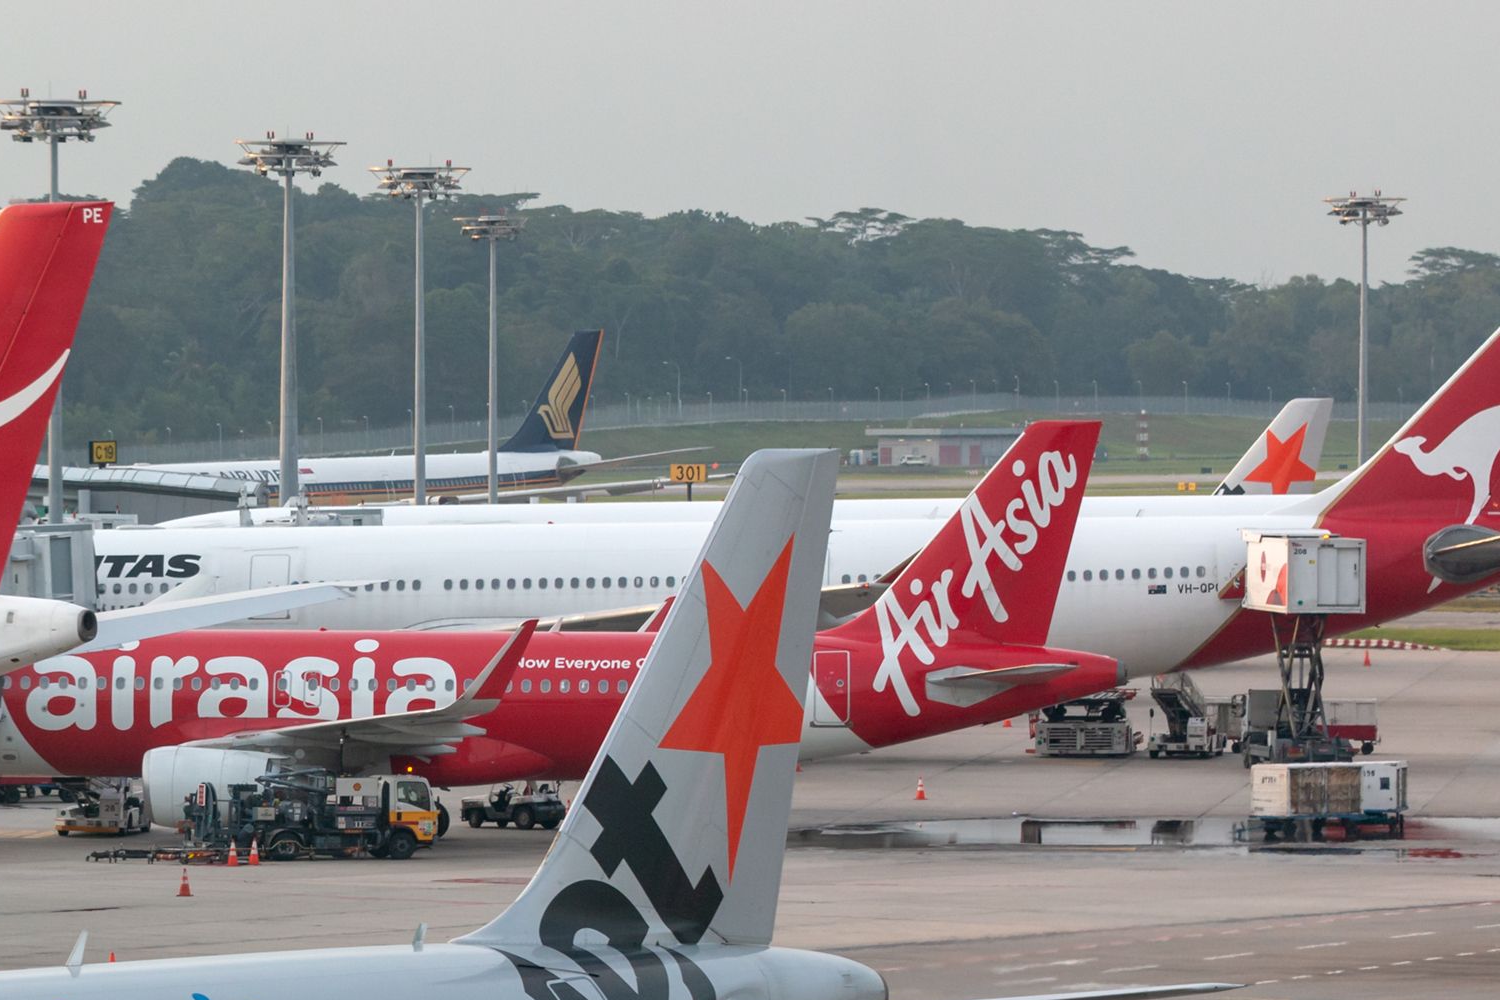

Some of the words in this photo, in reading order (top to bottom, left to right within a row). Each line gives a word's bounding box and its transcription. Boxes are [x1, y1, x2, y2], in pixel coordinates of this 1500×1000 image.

[82, 207, 104, 224] PE
[676, 465, 700, 480] 301
[95, 554, 202, 579] TAS
[554, 657, 631, 671] Everyone
[25, 638, 457, 732] airasia
